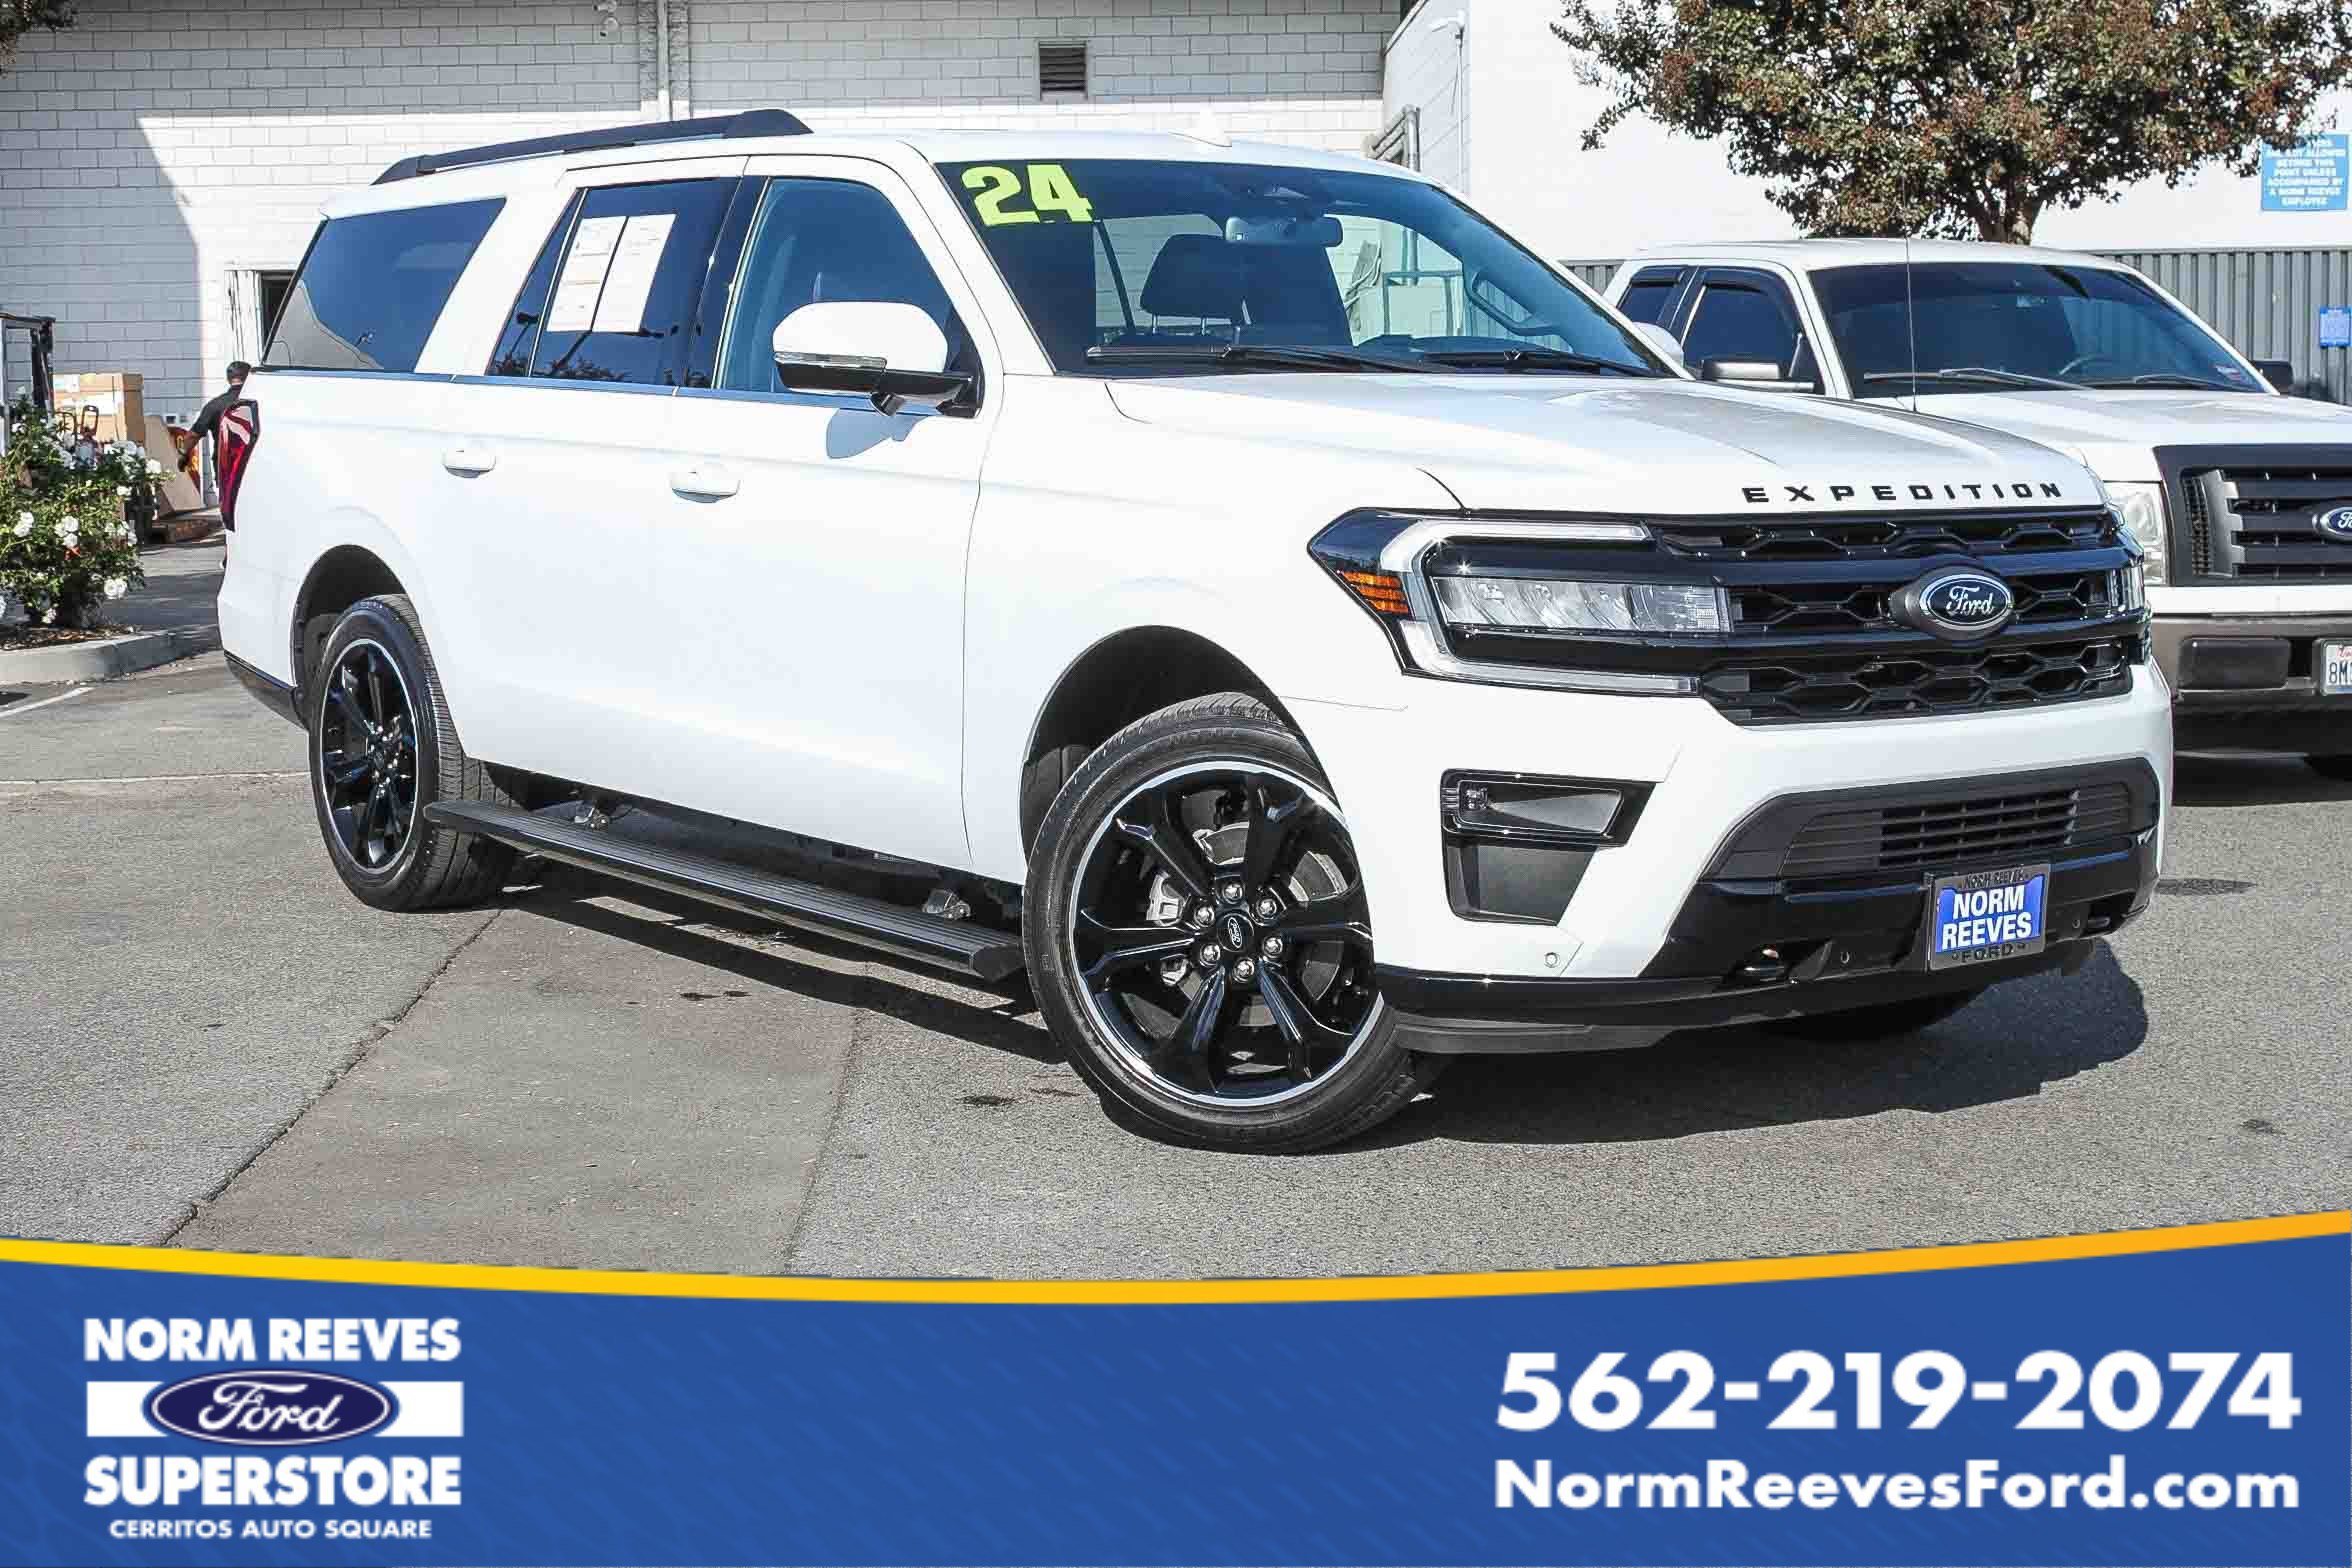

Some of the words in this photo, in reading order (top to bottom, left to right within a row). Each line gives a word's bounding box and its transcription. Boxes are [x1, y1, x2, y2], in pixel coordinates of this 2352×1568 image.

[962, 164, 1093, 226] 24
[1741, 482, 2062, 503] EXPEDITION
[1946, 585, 1995, 617] Ford
[1953, 884, 2025, 919] NORM
[1942, 912, 2032, 950] REEVES
